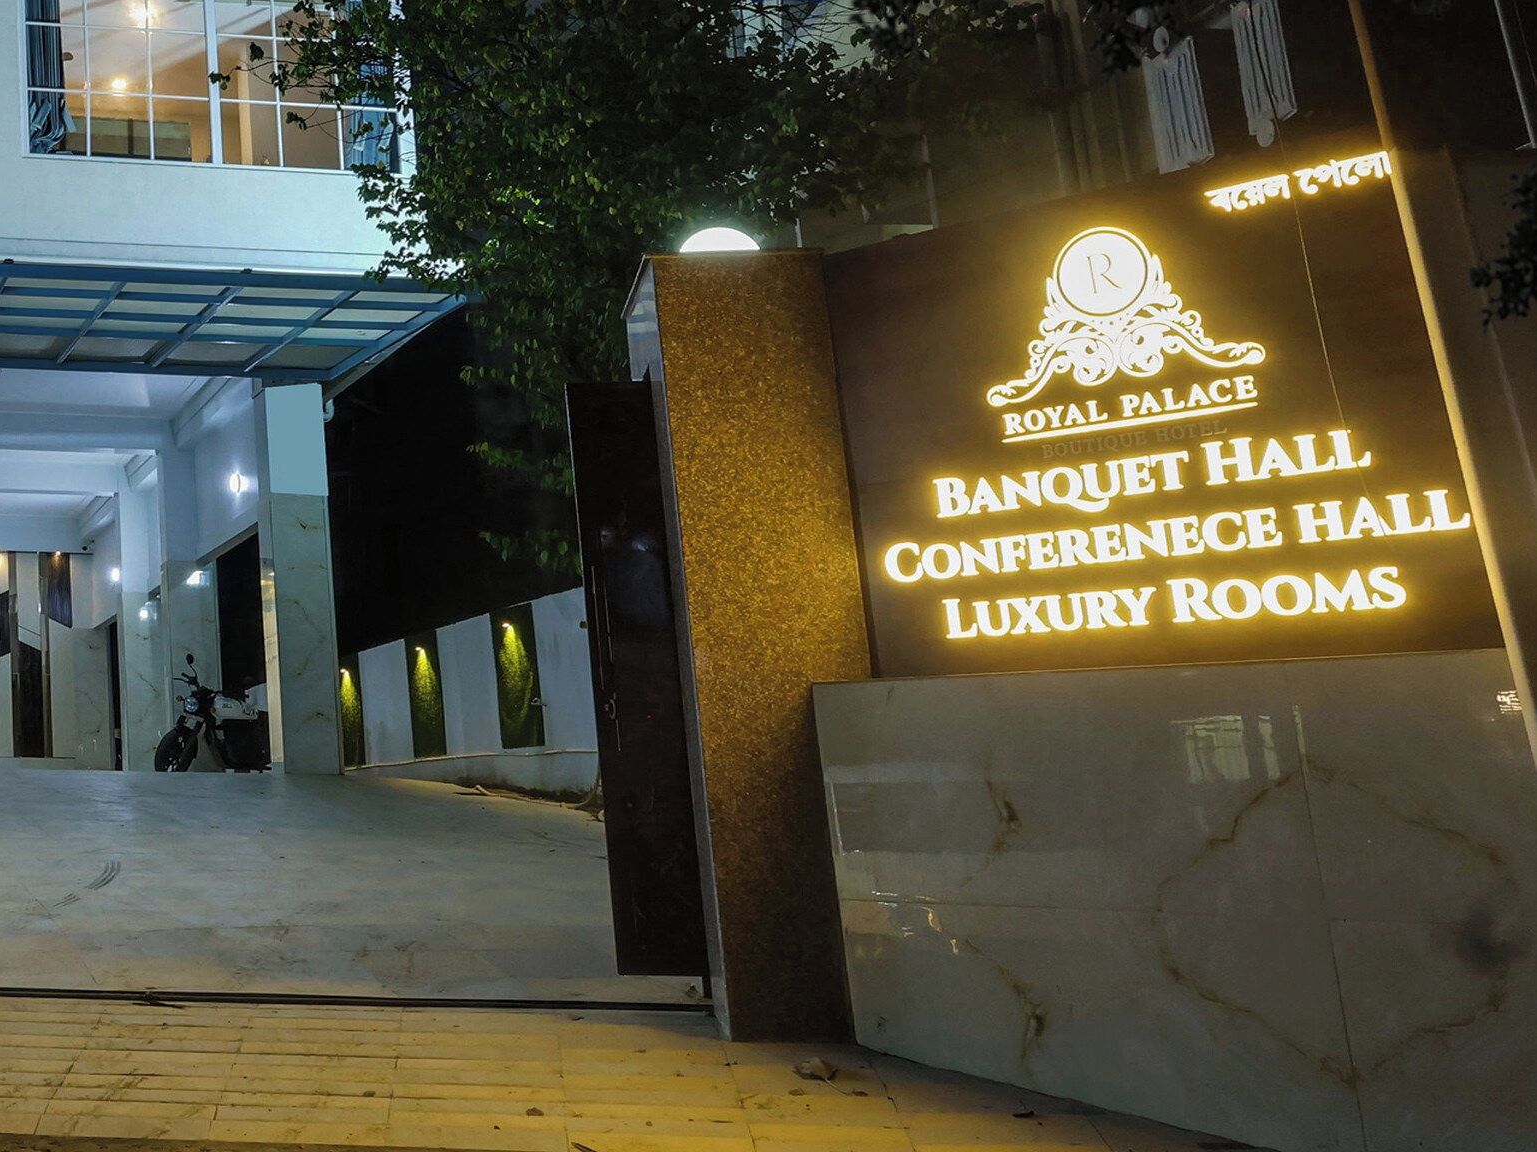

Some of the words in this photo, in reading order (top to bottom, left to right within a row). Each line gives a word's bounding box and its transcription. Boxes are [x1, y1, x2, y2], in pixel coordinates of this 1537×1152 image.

[1086, 252, 1123, 294] R
[1002, 400, 1108, 436] ROYAL
[1119, 375, 1258, 418] PALACE
[1041, 431, 1147, 459] BOUTIQUE
[1155, 419, 1228, 444] HOTEL
[932, 450, 1190, 519] BANQUET
[1201, 428, 1373, 487] HALL
[883, 505, 1284, 584] CONFERENECE
[1292, 488, 1472, 545] HALL
[940, 585, 1158, 640] LUXURY
[1165, 565, 1408, 625] ROOMS
